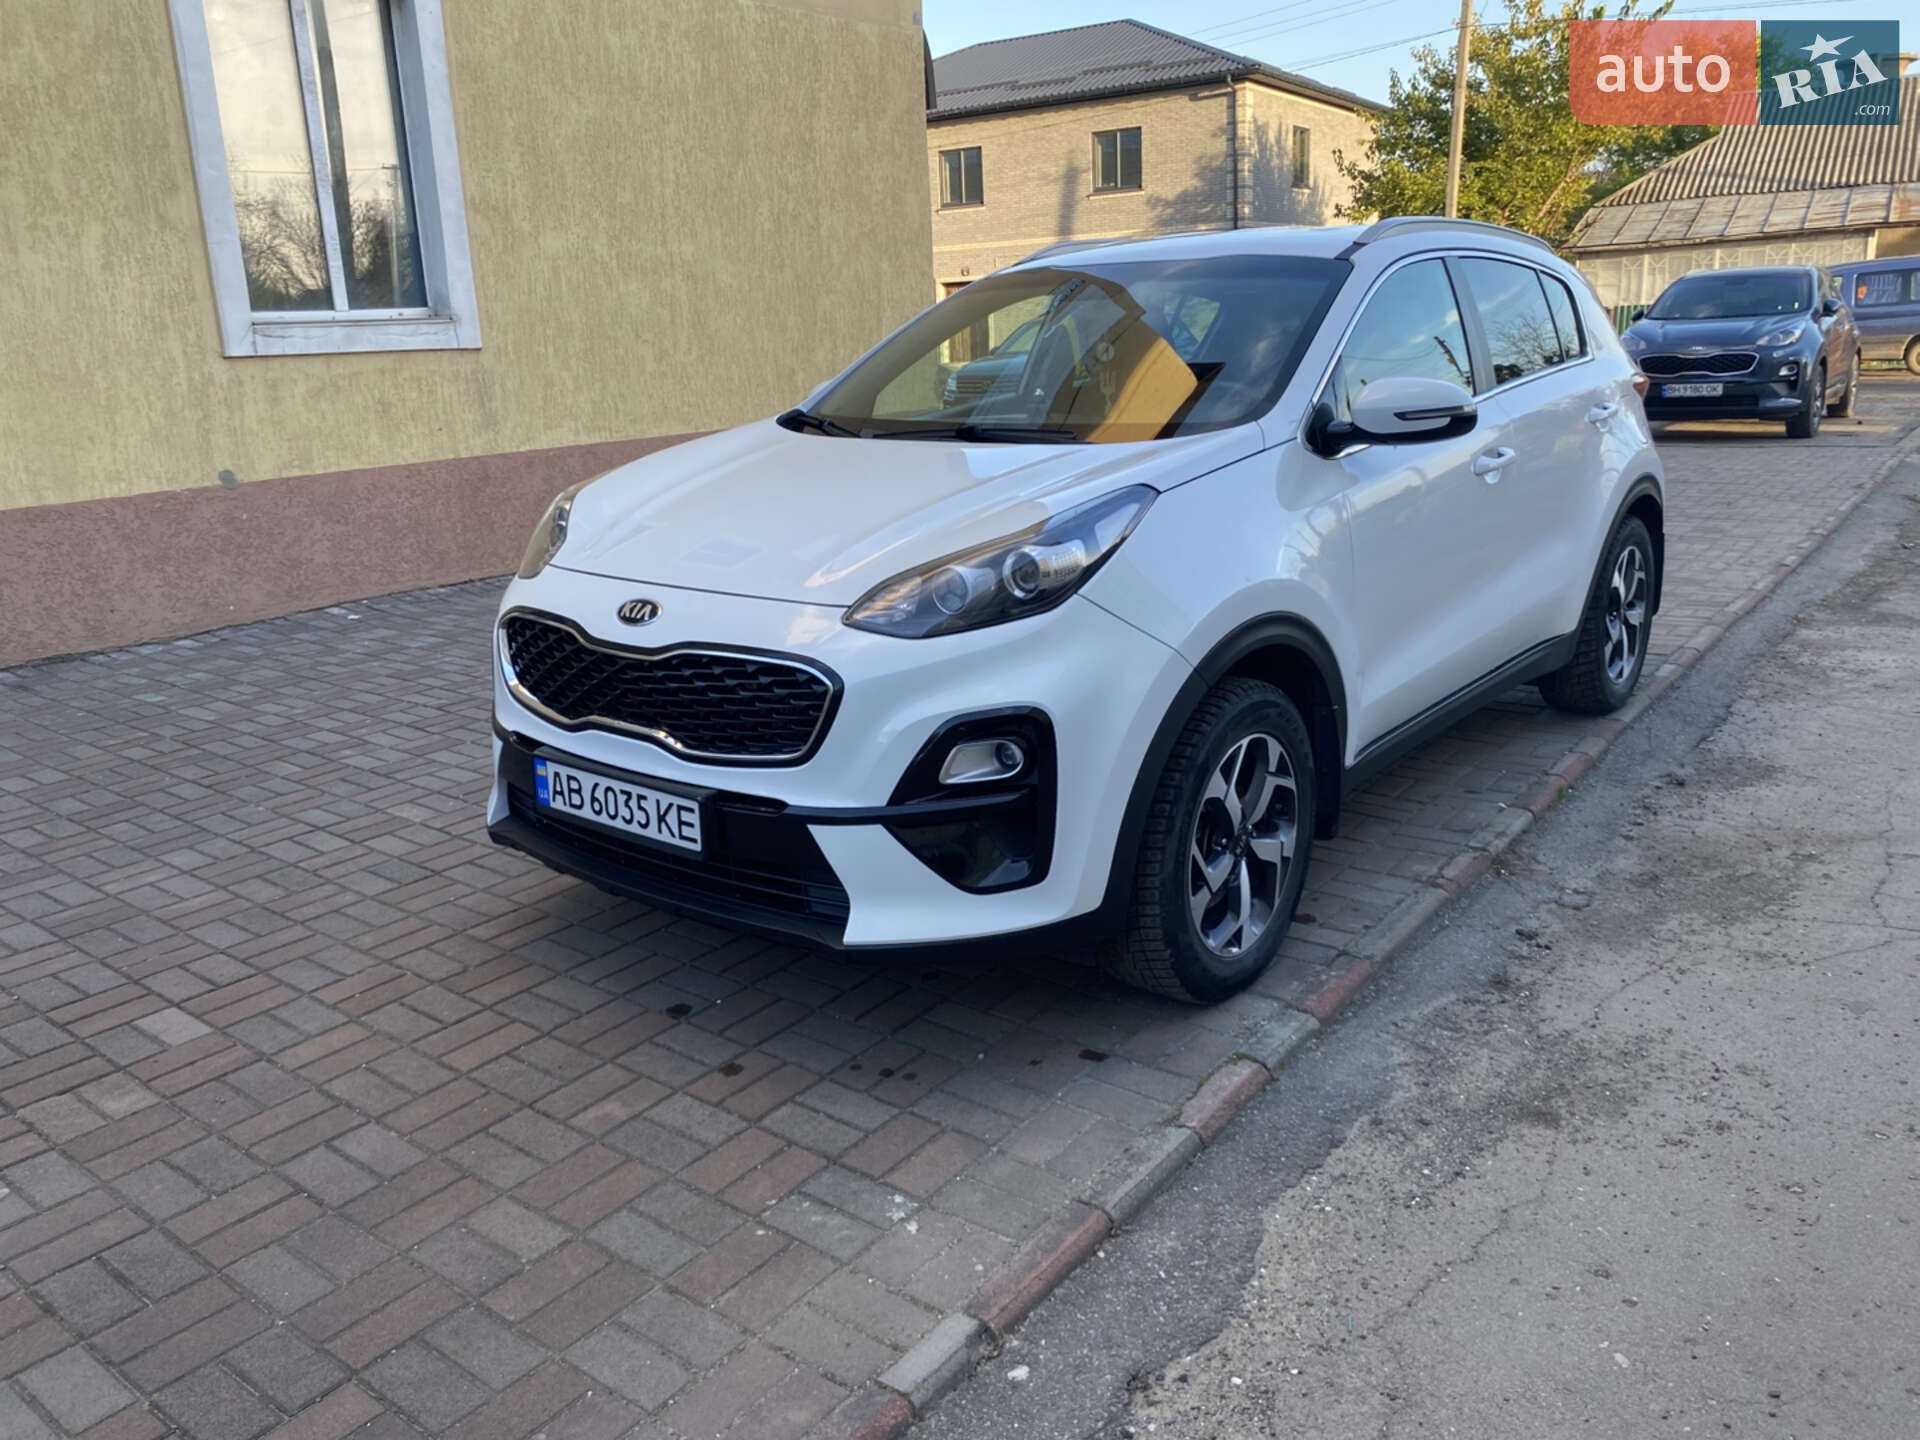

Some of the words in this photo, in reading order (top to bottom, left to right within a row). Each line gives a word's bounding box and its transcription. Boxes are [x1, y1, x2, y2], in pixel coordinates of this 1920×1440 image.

[620, 602, 653, 620] KIA
[590, 781, 651, 830] 6035
[655, 798, 699, 845] KE
